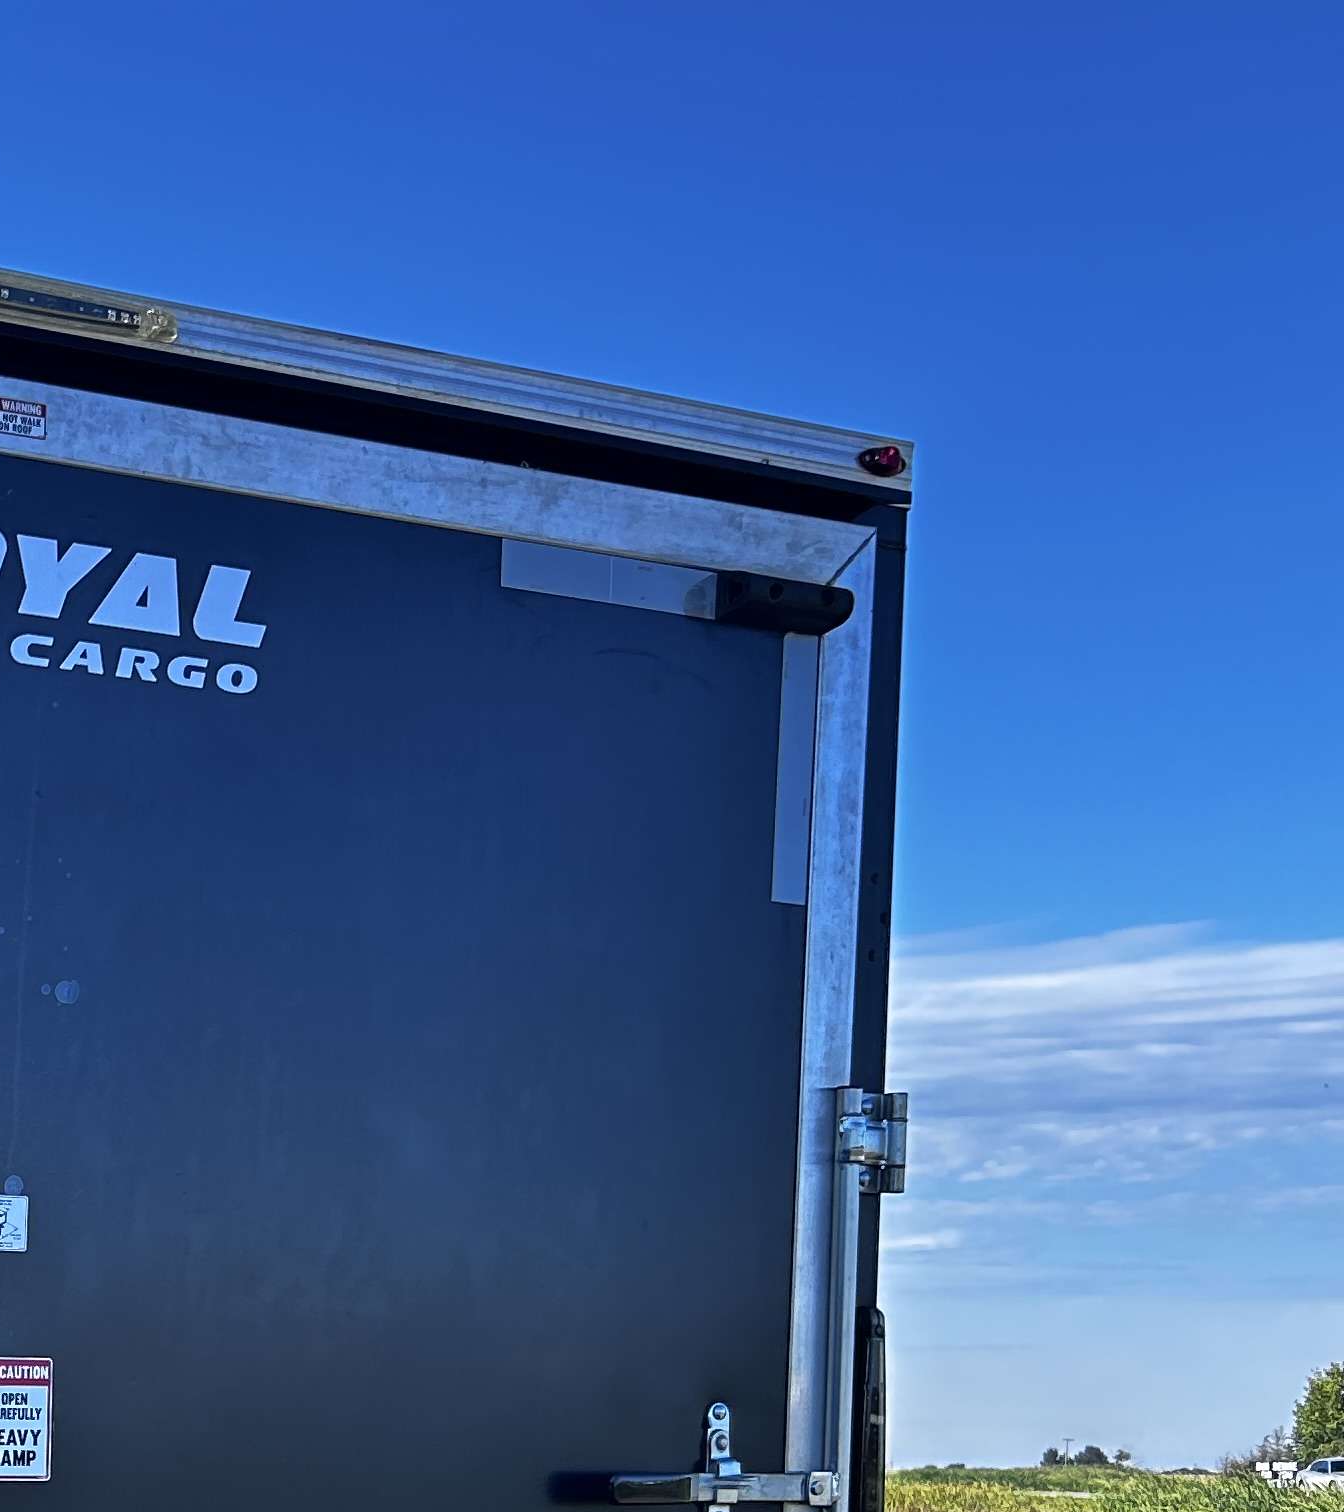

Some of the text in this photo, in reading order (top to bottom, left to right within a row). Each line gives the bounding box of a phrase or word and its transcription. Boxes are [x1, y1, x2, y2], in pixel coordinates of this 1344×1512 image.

[1, 399, 42, 416] WARNING
[3, 413, 18, 424] NOT
[20, 416, 42, 428] WALK
[13, 423, 33, 435] ROOF
[10, 634, 258, 694] CARGO
[0, 1365, 49, 1379] CAUTION
[1, 1393, 28, 1406] OPEN
